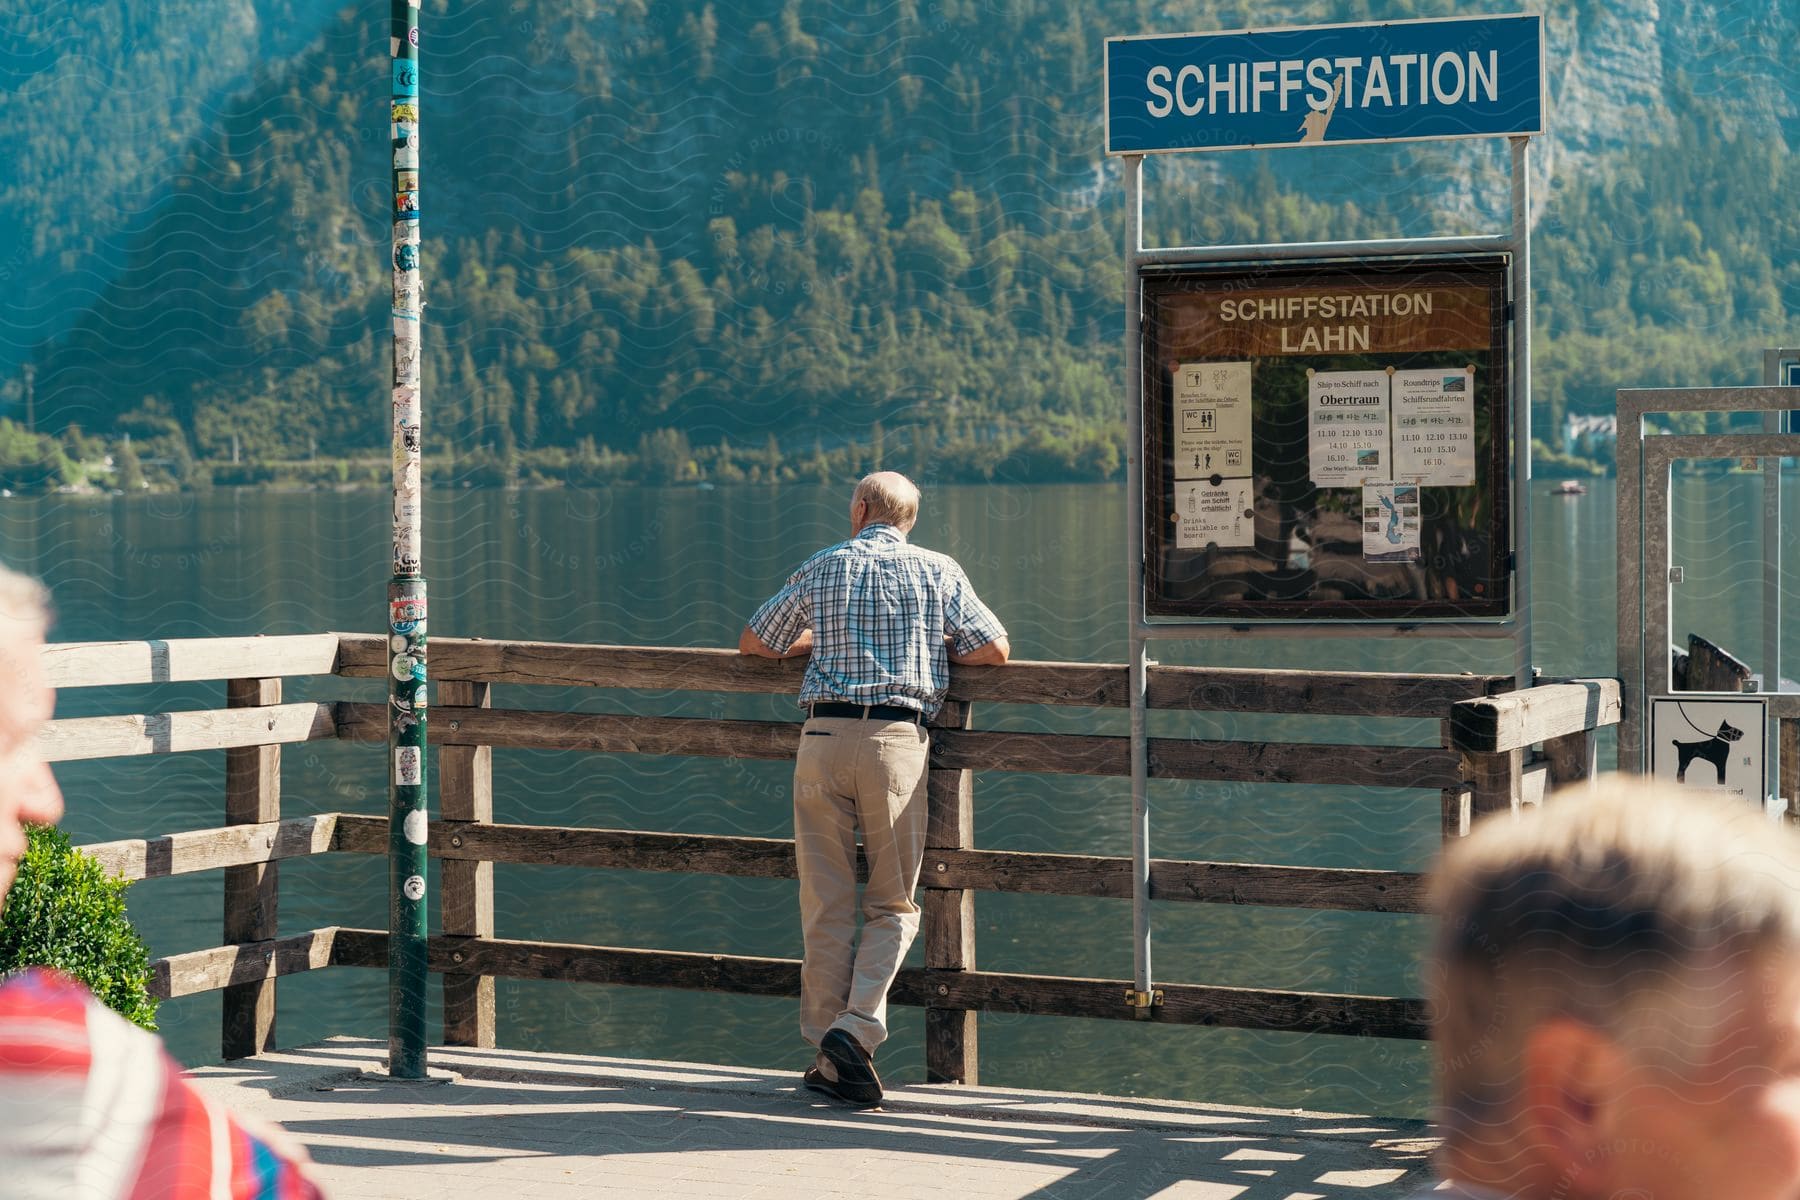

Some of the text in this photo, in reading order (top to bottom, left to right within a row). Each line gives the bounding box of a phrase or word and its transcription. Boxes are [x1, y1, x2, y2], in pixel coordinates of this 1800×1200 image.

[1146, 49, 1498, 118] SCHIFFSTATION
[1219, 292, 1433, 323] SCHIFFSTATION
[1281, 325, 1371, 353] LAHN
[1317, 381, 1333, 389] Ship
[1363, 379, 1379, 387] nach
[1403, 379, 1440, 388] Roundtrips
[1320, 394, 1380, 405] Obertraun
[1402, 395, 1465, 404] Schiffsrundfahrten
[1342, 429, 1361, 437] 12.10
[1364, 429, 1383, 437] 13.10
[1401, 433, 1468, 442] 11.10 12.10 13.10
[1201, 490, 1229, 498] Getränke
[1211, 497, 1231, 505] Schiff
[1201, 504, 1232, 512] erhältlich!
[1183, 524, 1218, 532] available
